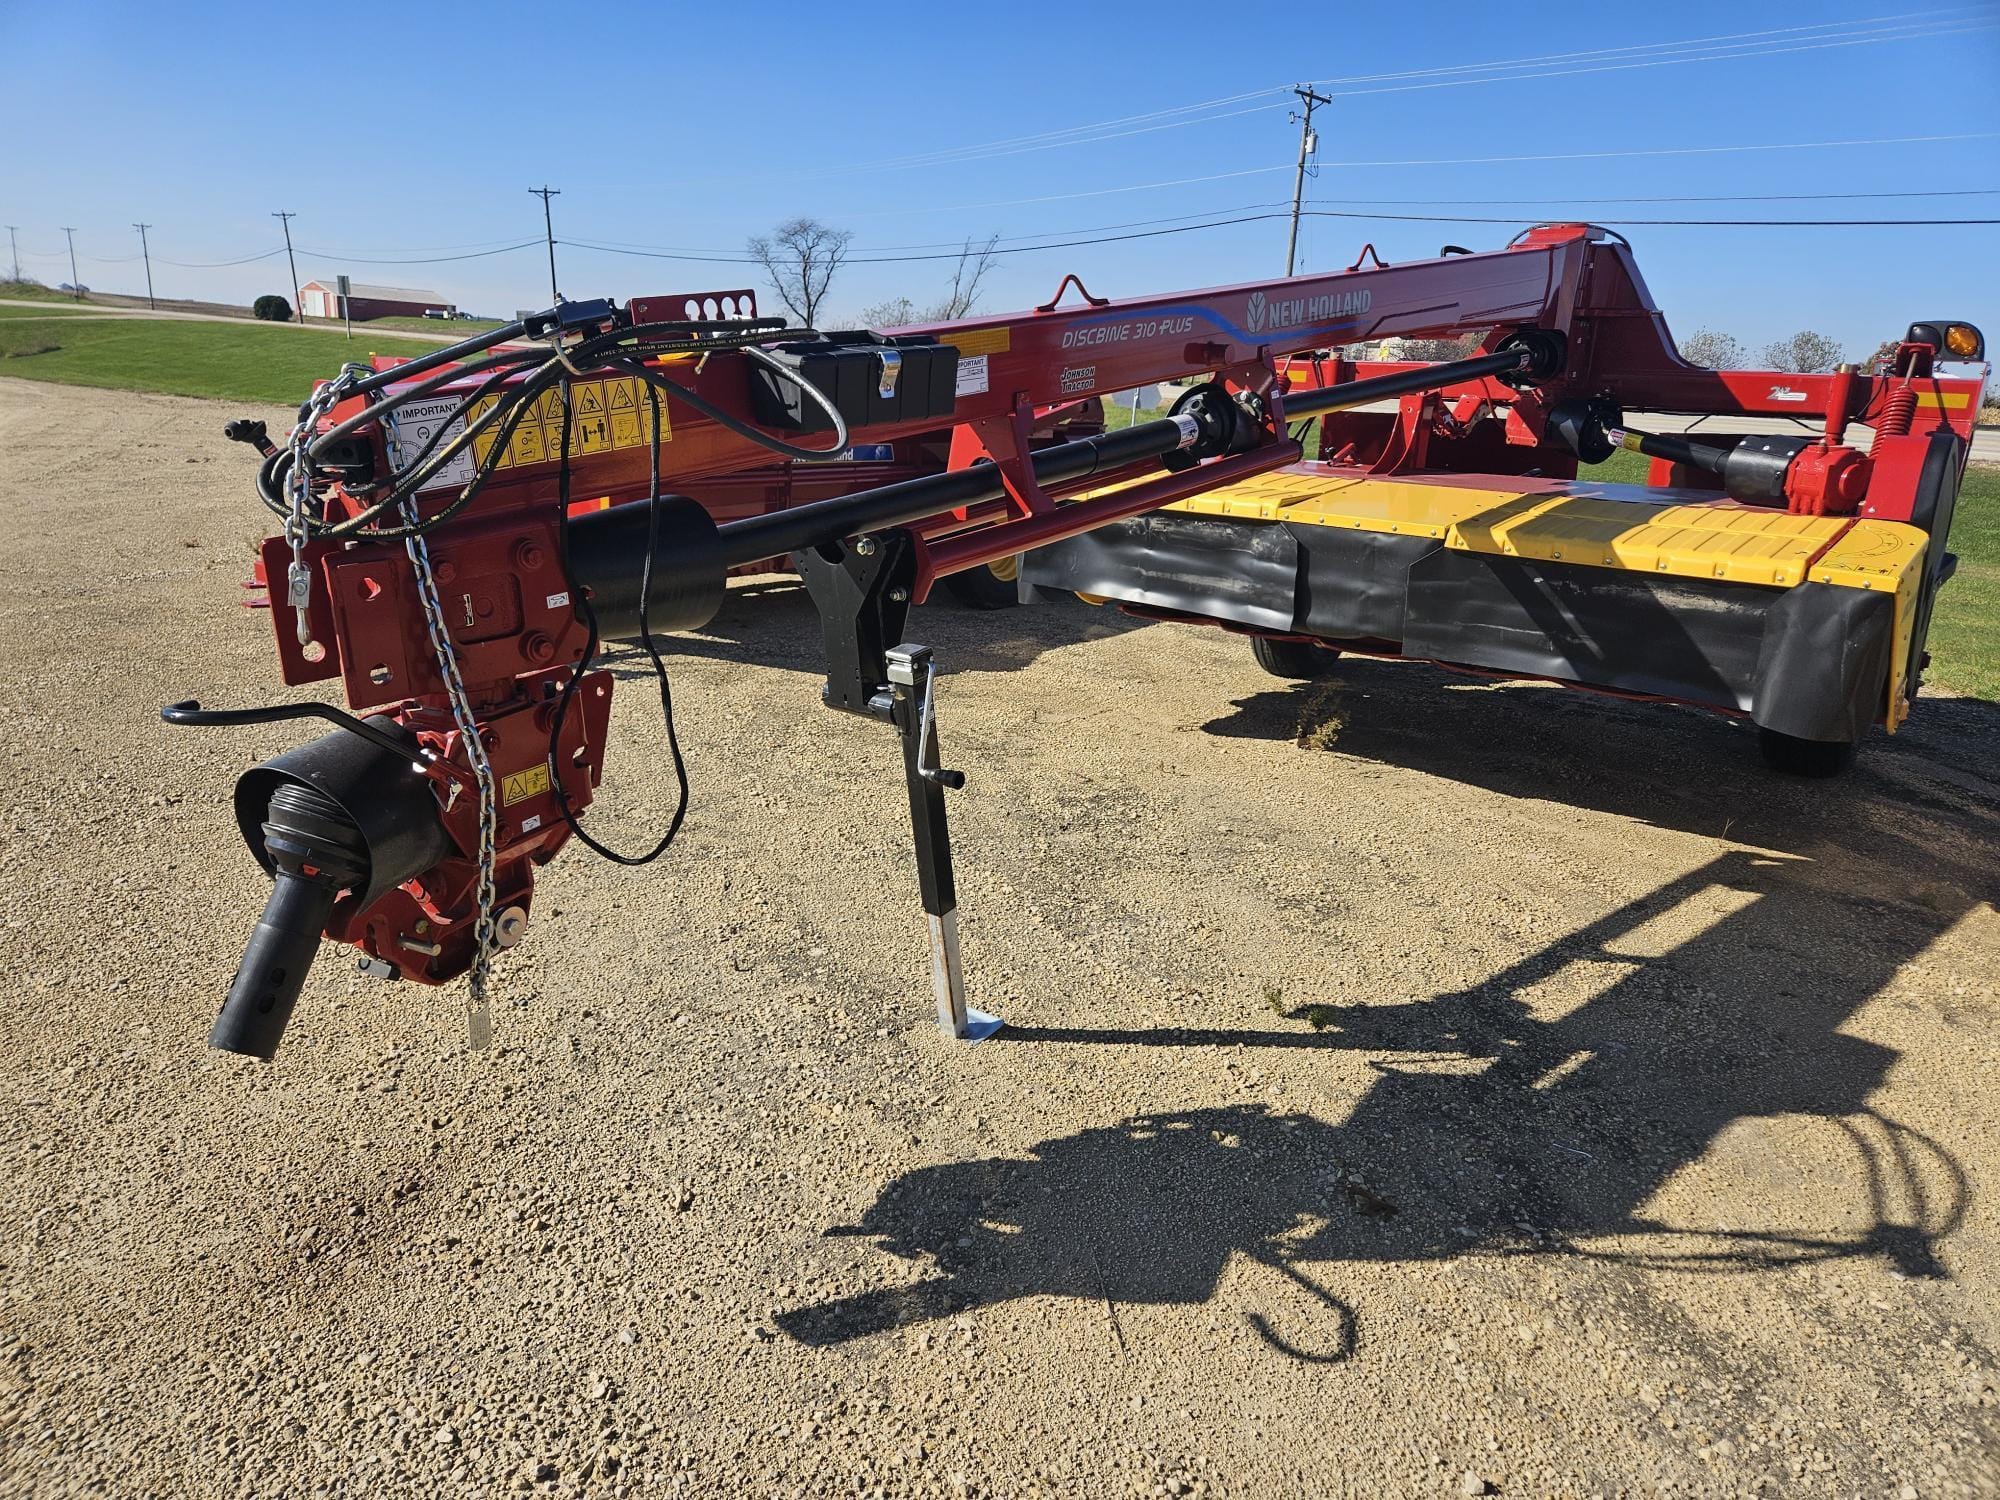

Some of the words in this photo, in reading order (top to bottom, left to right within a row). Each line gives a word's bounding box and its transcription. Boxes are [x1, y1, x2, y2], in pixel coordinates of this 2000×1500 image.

[1269, 299, 1304, 328] NEW
[1308, 289, 1372, 321] HOLLAND
[1062, 324, 1131, 348] DISCBINE
[1133, 321, 1157, 340] 310
[958, 359, 984, 368] PORTANT
[1061, 366, 1095, 381] JOHNSON
[1061, 379, 1095, 393] TRACTOR
[402, 403, 458, 419] IMPORTANT
